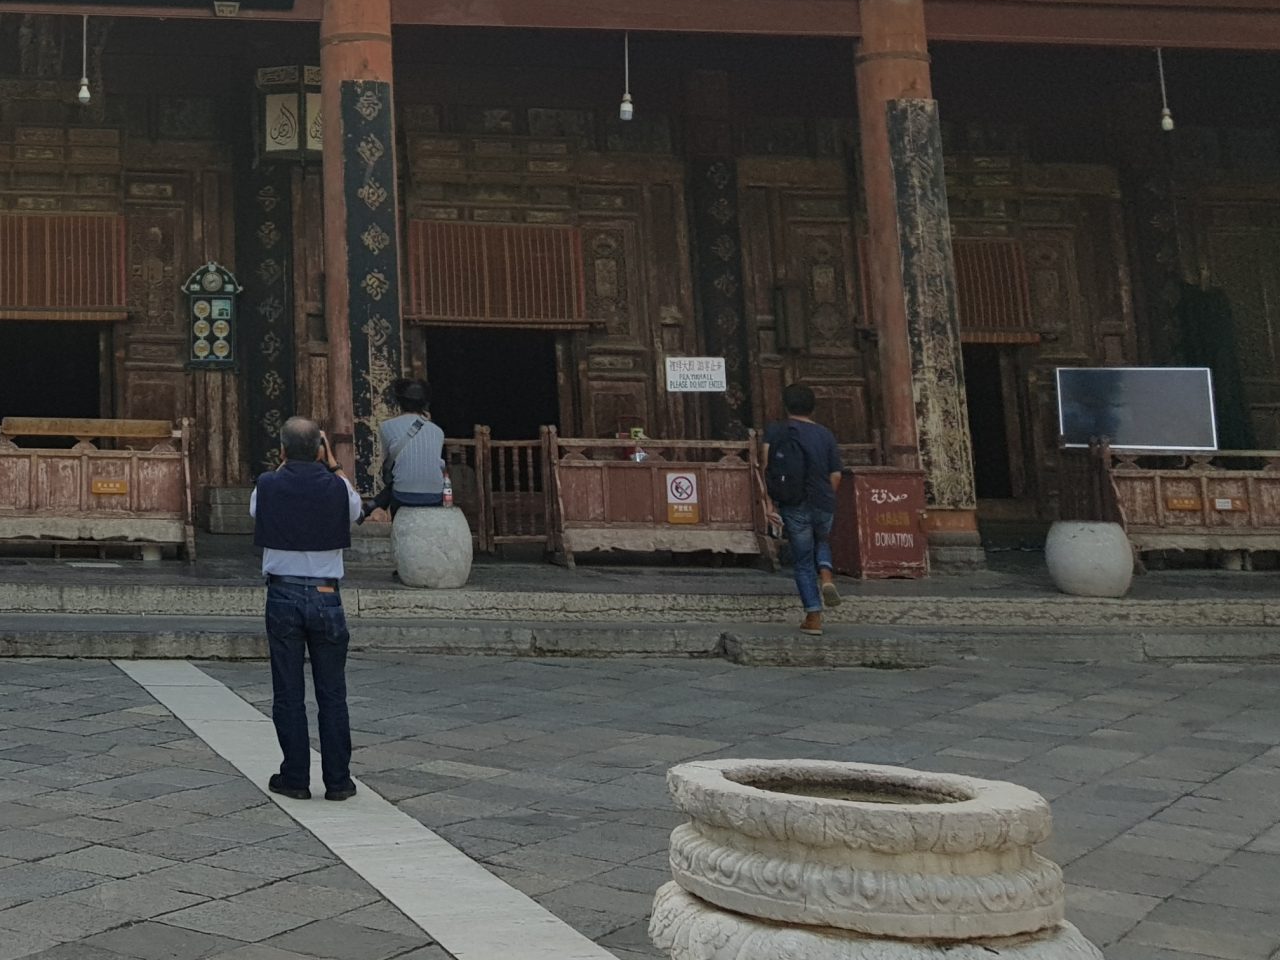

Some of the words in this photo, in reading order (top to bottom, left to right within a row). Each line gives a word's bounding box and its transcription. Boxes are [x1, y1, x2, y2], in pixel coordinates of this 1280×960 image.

[670, 381, 688, 389] PLEASE
[871, 489, 908, 504] صدقة
[875, 532, 914, 548] DONATION
